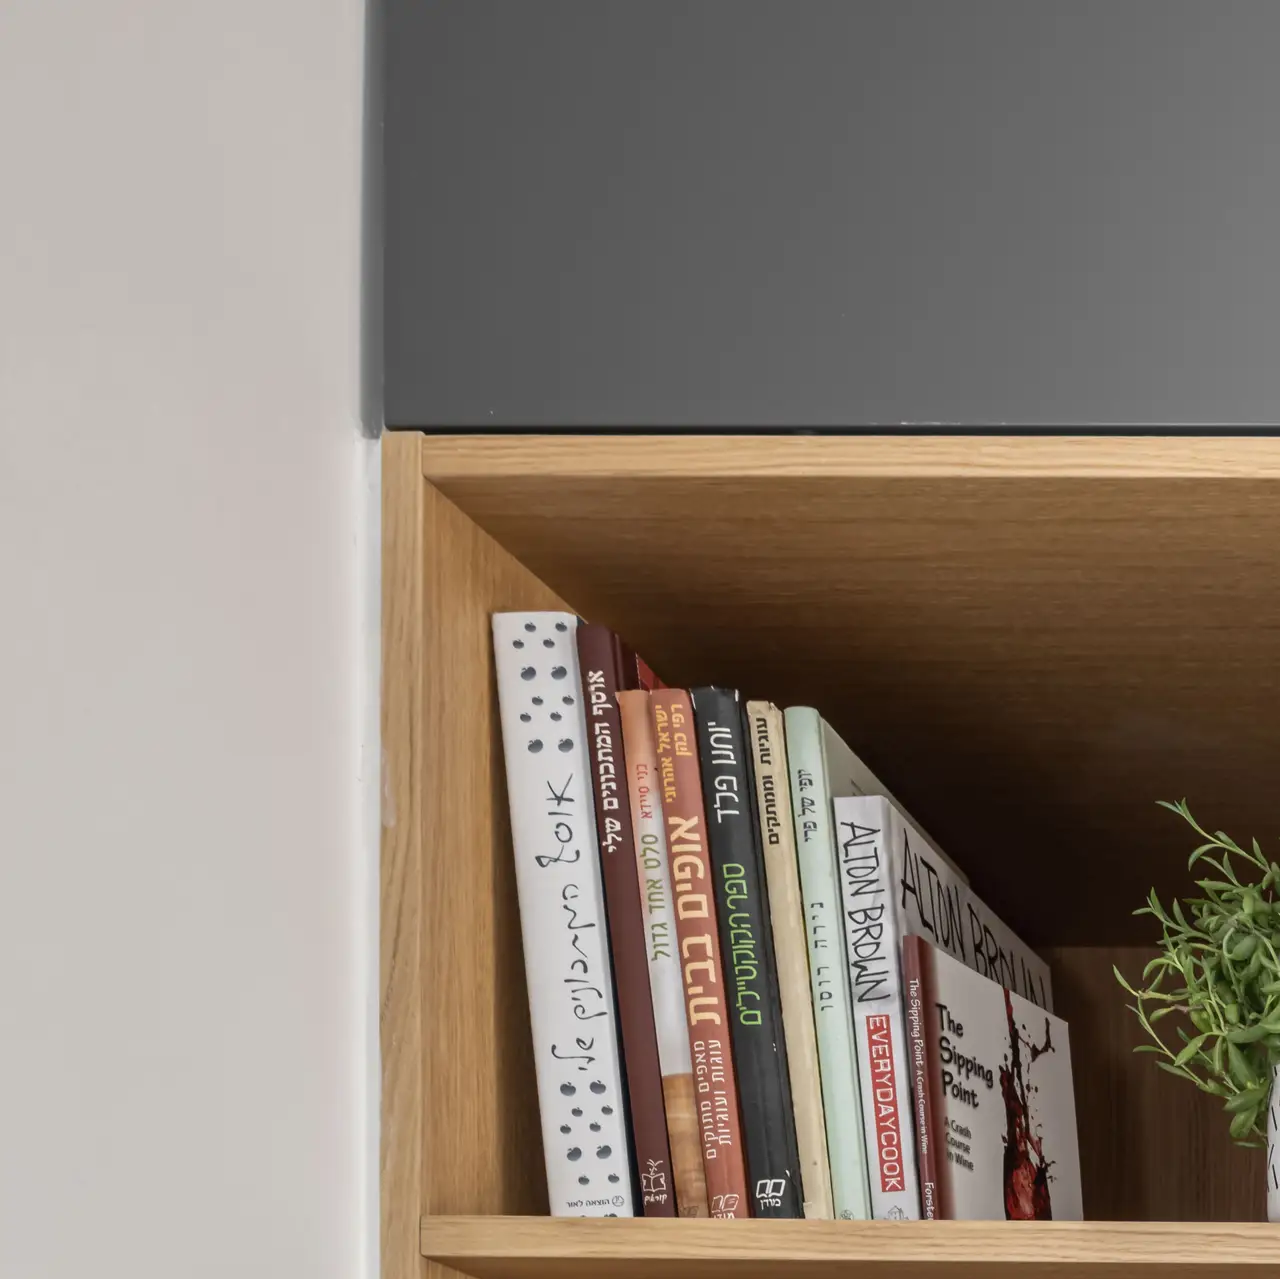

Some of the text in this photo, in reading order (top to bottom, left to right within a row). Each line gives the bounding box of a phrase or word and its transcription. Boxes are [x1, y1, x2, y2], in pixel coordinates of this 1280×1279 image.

[588, 670, 623, 853] אוסף המתכונים שלי
[636, 764, 648, 781] בני
[655, 704, 677, 803] ישראל אהרוני
[671, 703, 693, 757] רפי כהן
[707, 721, 740, 824] יוחנן פלד
[756, 717, 781, 845] עוגיות וממתקים
[797, 768, 818, 843] יופי של פרי
[534, 772, 608, 1071] אוסף המתכונים שלי
[639, 833, 671, 962] סלט אחד גדול
[668, 815, 722, 1027] אופים בבית
[722, 862, 763, 1026] ספר הקוקטיילים
[840, 821, 891, 1003] ALTON BROWN
[900, 827, 966, 963] ALTON
[810, 902, 834, 1012] נירה רוסו
[909, 977, 921, 997] The
[908, 999, 922, 1038] Sipping
[914, 1039, 924, 1067] Point
[935, 1002, 964, 1039] The
[939, 1035, 994, 1090] Sipping
[693, 1040, 719, 1160] מאפים מתוקים
[708, 1039, 732, 1146] עוגות ועוגיות
[868, 1015, 902, 1191] EVERYDAYCOOK
[941, 1068, 980, 1109] Point
[924, 1182, 935, 1220] Forste
[955, 1151, 975, 1172] Wine
